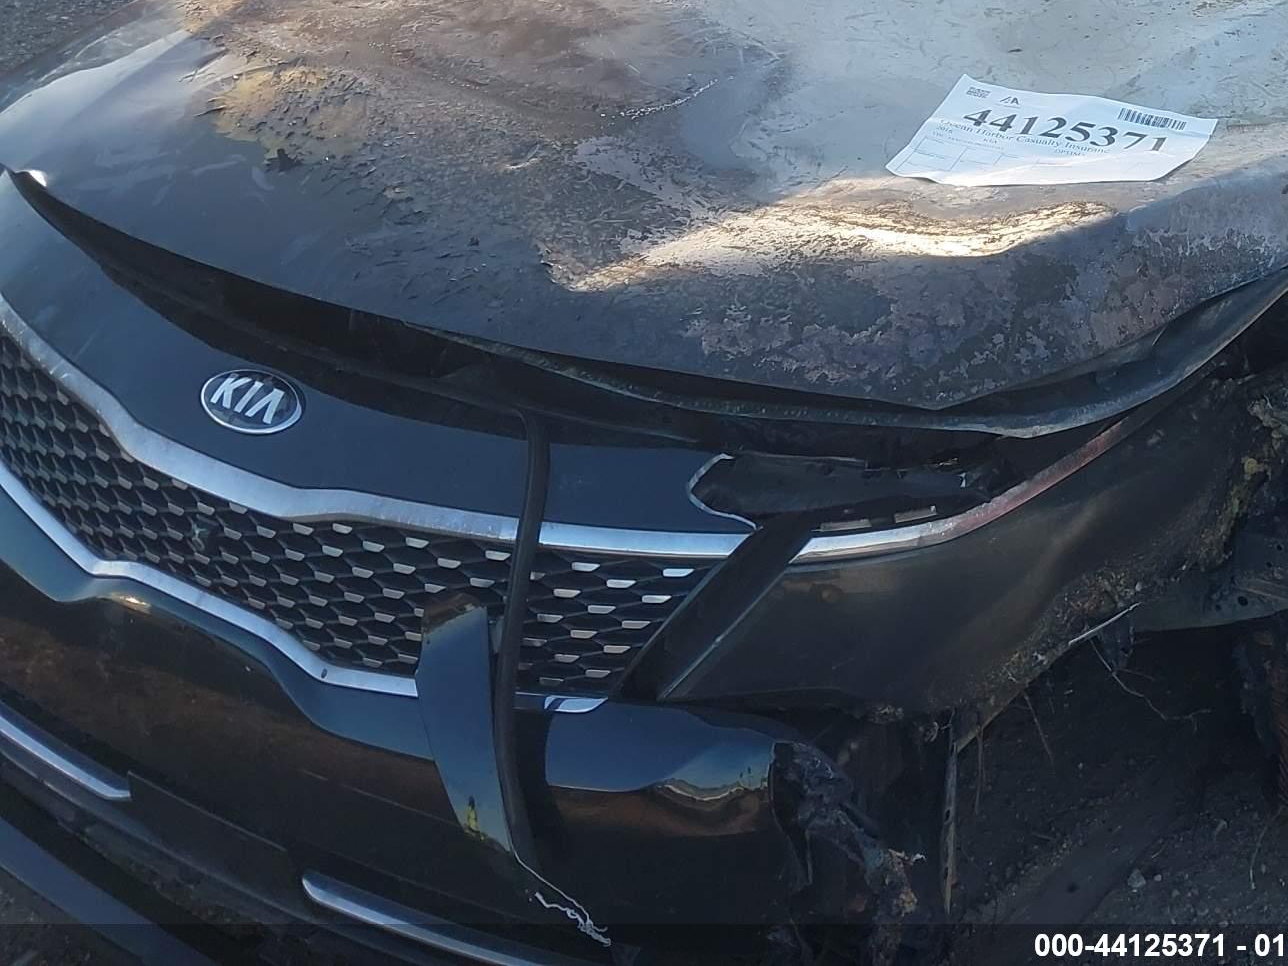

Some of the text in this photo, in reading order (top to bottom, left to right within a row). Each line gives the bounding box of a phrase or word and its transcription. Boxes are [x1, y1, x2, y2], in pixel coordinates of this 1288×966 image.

[962, 109, 1168, 152] 44125371
[976, 128, 1014, 141] Harbor
[1016, 135, 1060, 148] Casualty
[210, 374, 285, 424] KIA
